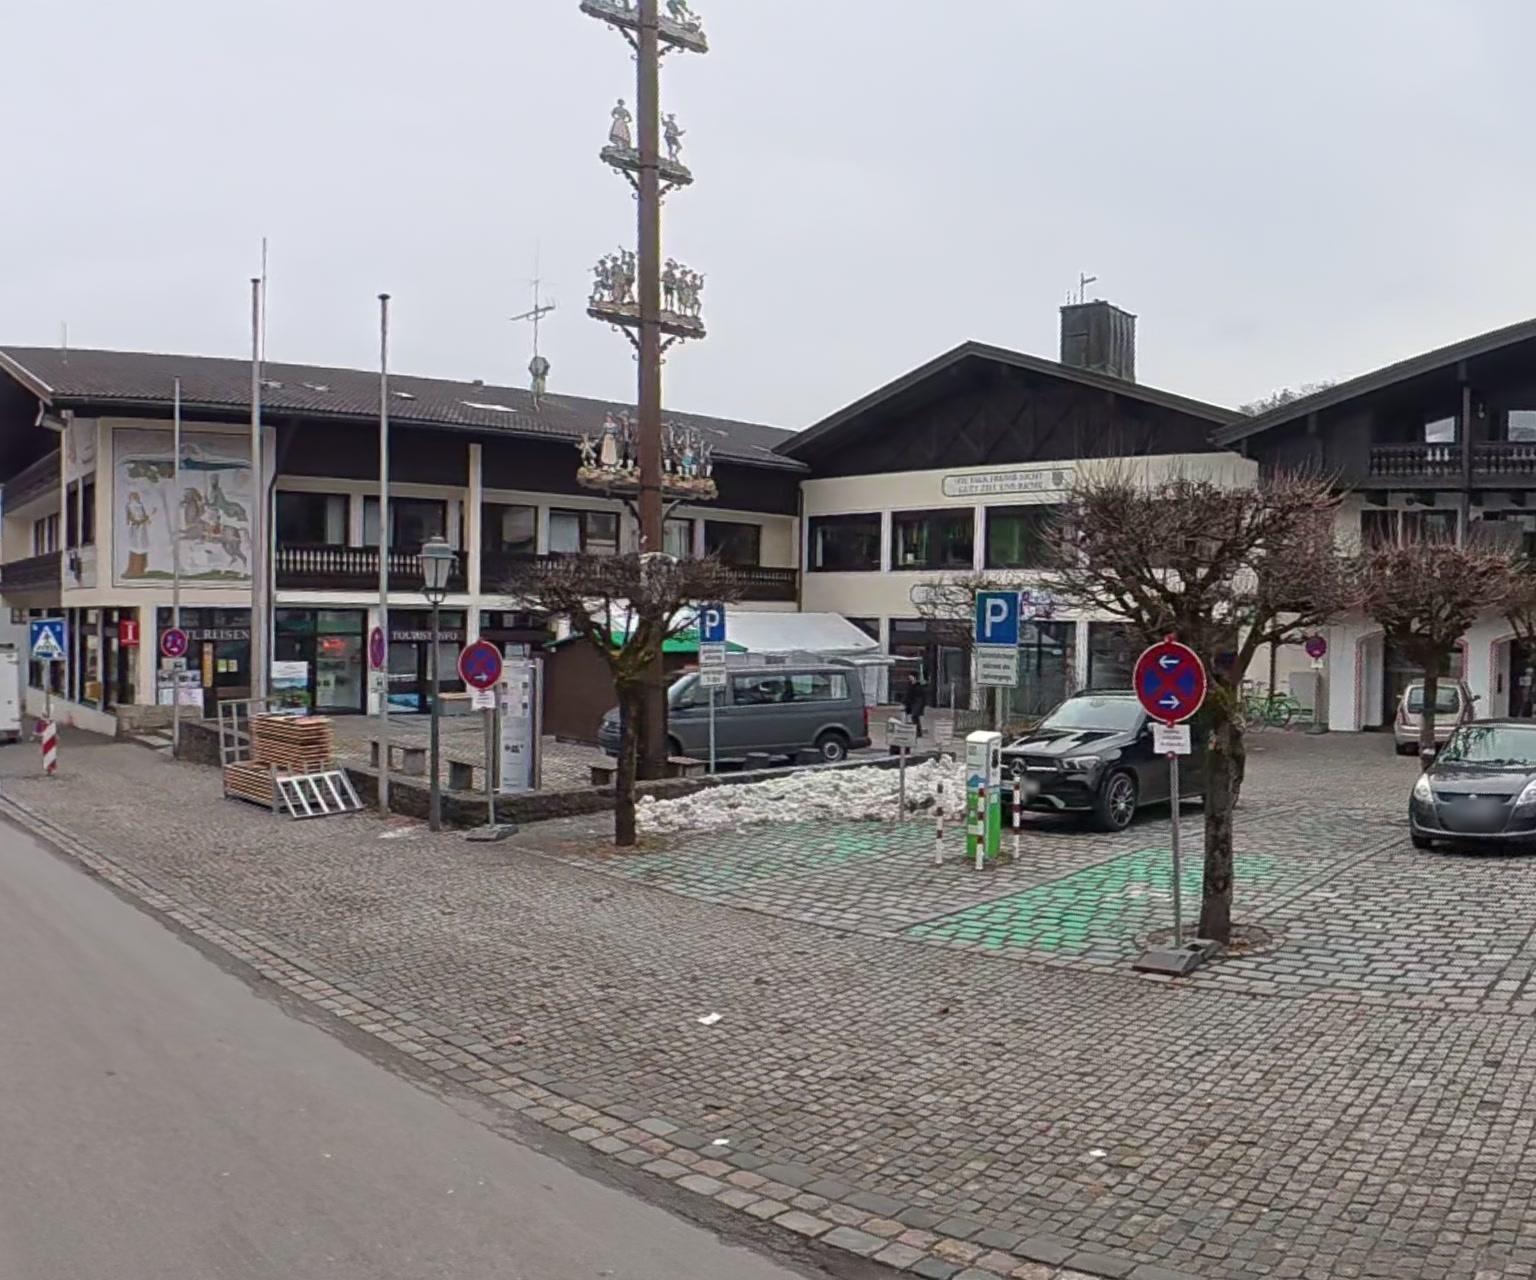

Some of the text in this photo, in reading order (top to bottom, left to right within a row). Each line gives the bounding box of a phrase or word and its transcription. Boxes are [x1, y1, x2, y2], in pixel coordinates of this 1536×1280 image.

[705, 609, 720, 639] P
[984, 598, 1008, 637] P
[203, 628, 250, 640] REISEN
[392, 630, 432, 641] TOURIST
